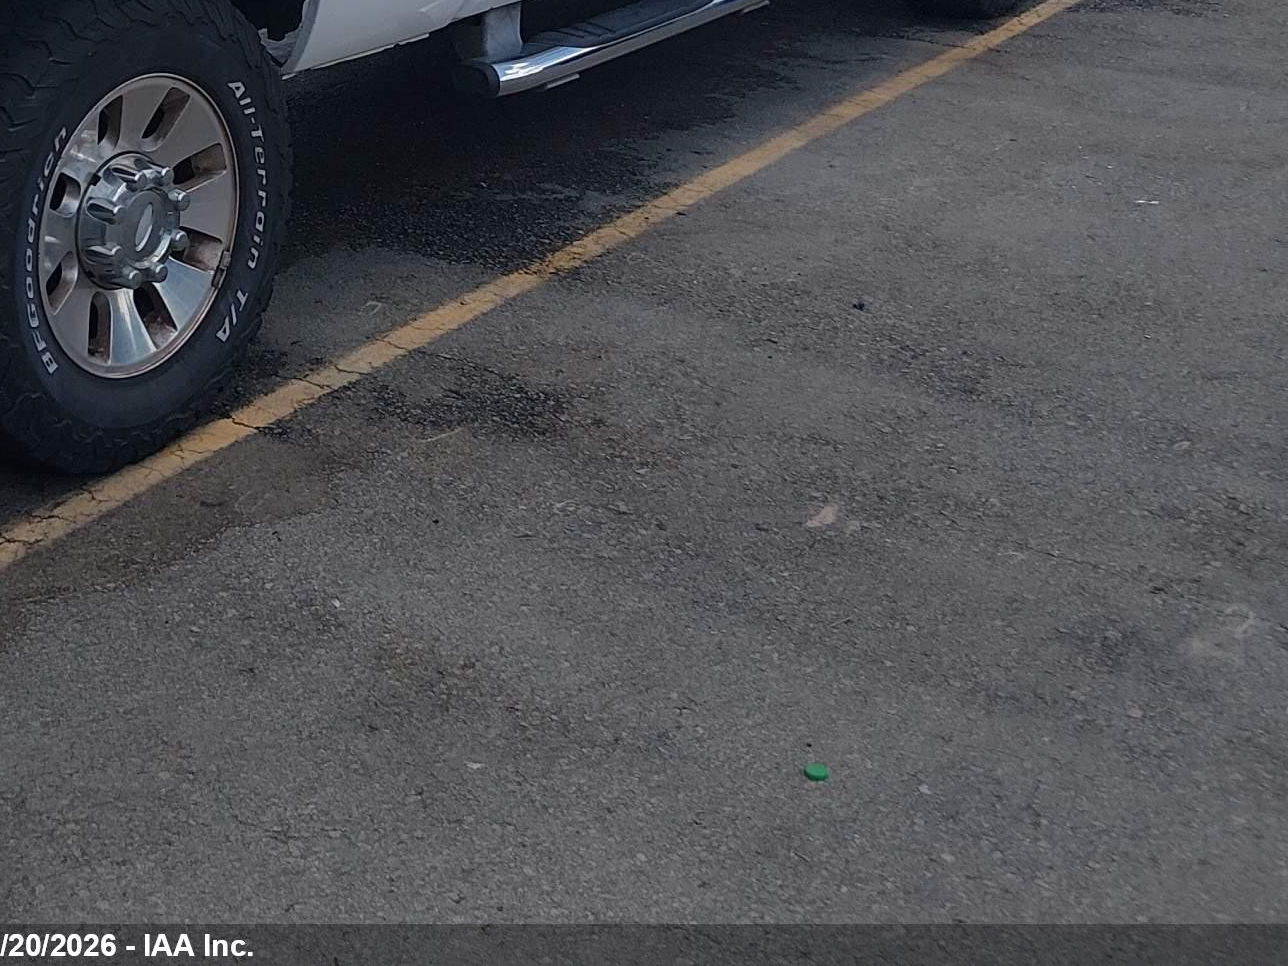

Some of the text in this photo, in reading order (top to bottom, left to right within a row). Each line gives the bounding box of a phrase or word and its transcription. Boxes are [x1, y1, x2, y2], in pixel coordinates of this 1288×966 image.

[25, 127, 67, 375] BFGoodrich
[215, 81, 268, 342] All-Terrain T/A
